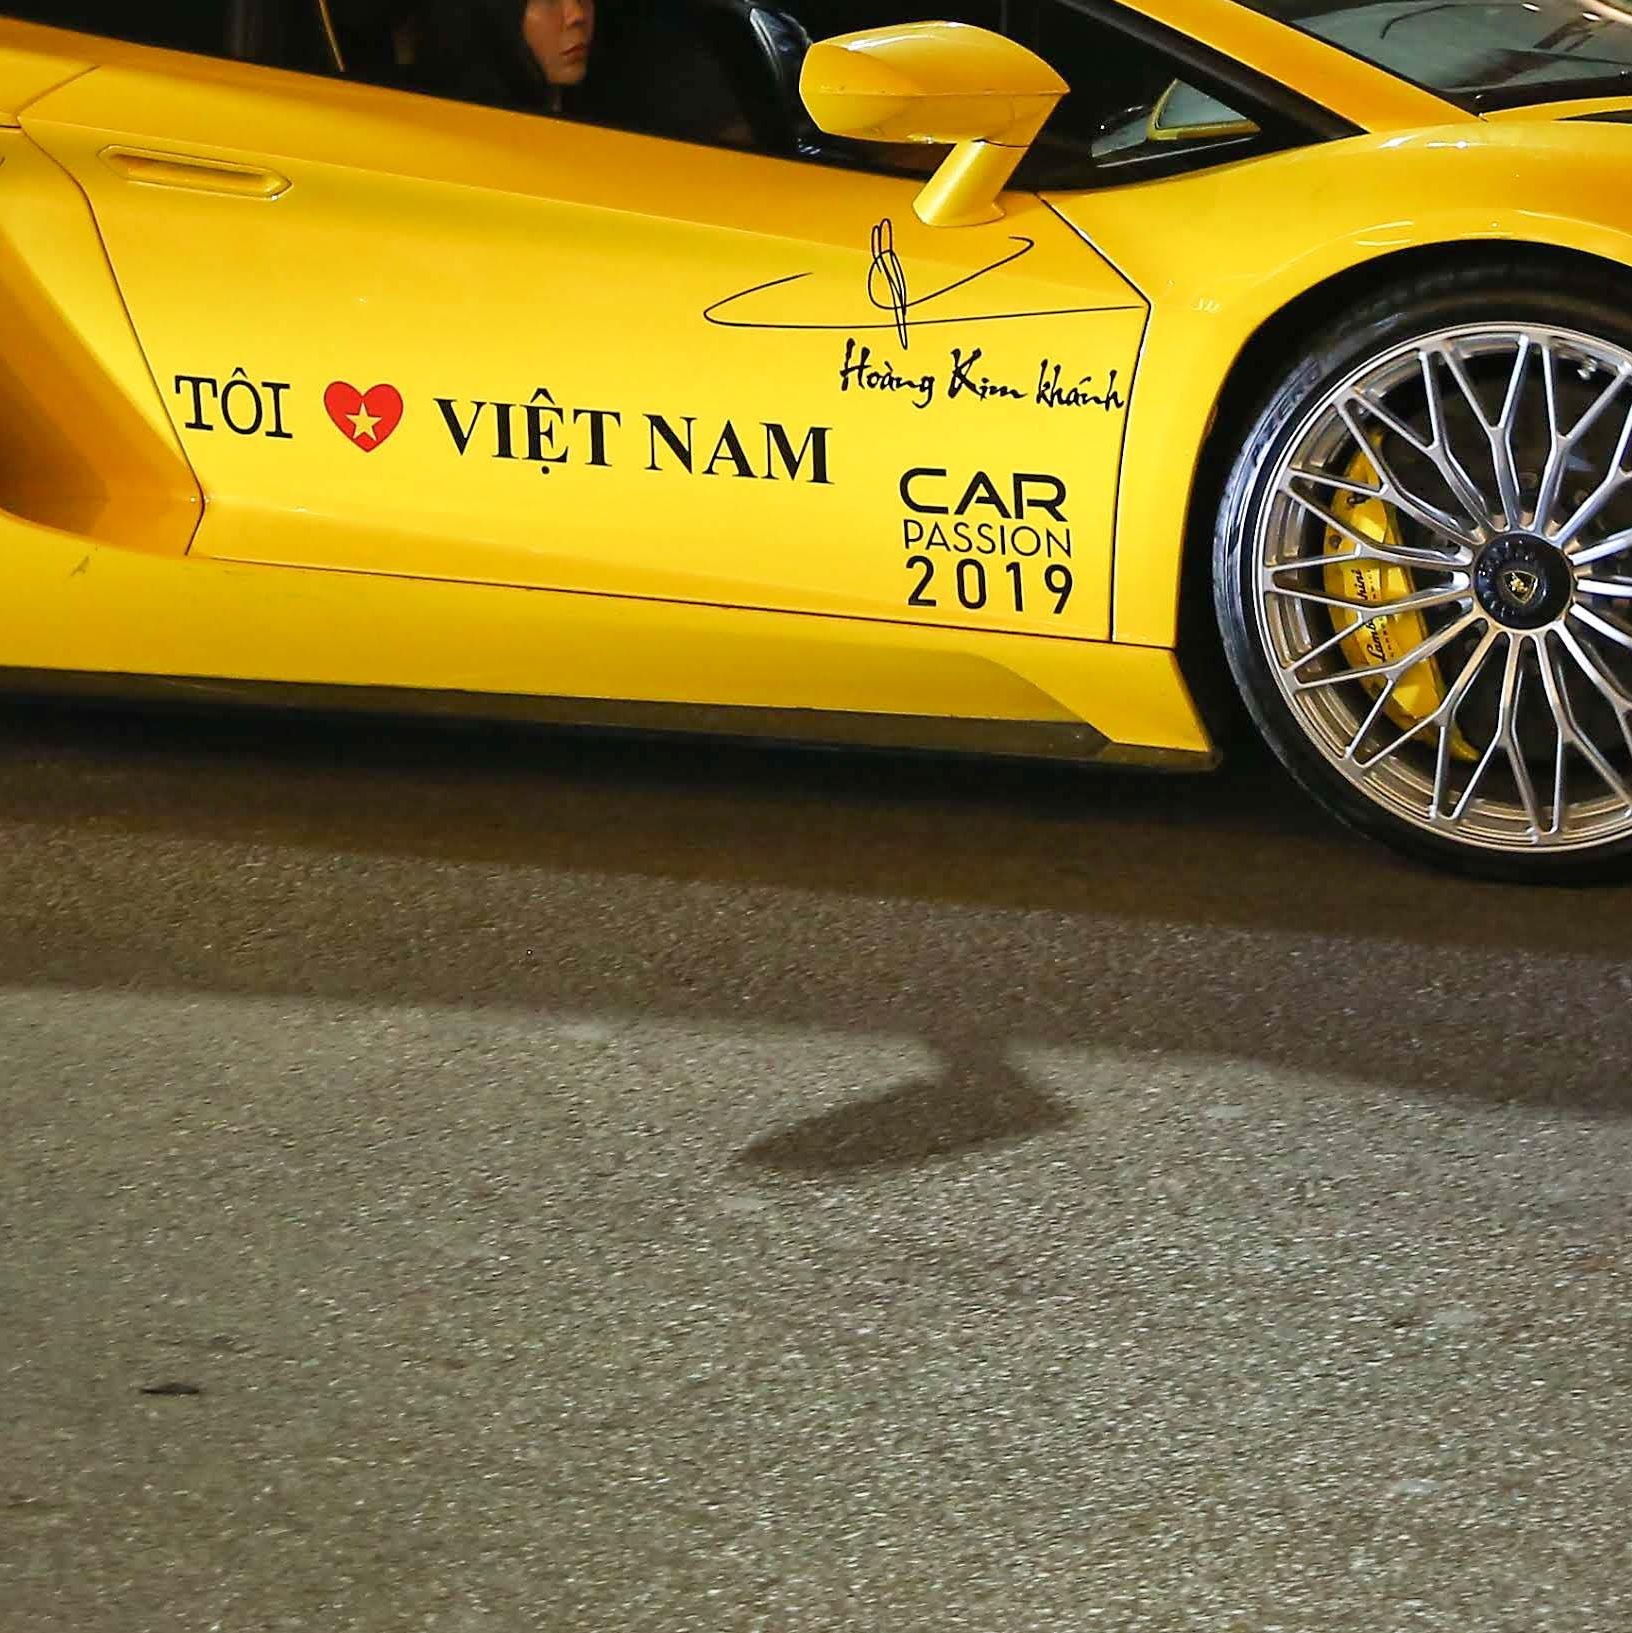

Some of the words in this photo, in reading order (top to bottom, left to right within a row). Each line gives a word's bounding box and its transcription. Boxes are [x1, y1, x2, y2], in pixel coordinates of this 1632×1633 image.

[840, 338, 935, 409] Hoàng
[947, 348, 1028, 401] Kim
[174, 366, 293, 439] TÔI
[433, 386, 622, 476] VIỆT
[644, 414, 834, 485] NAM
[899, 467, 1069, 523] CAR
[903, 518, 1073, 558] PASSION
[906, 555, 1075, 615] 2019
[1351, 568, 1387, 663] Lambhini
